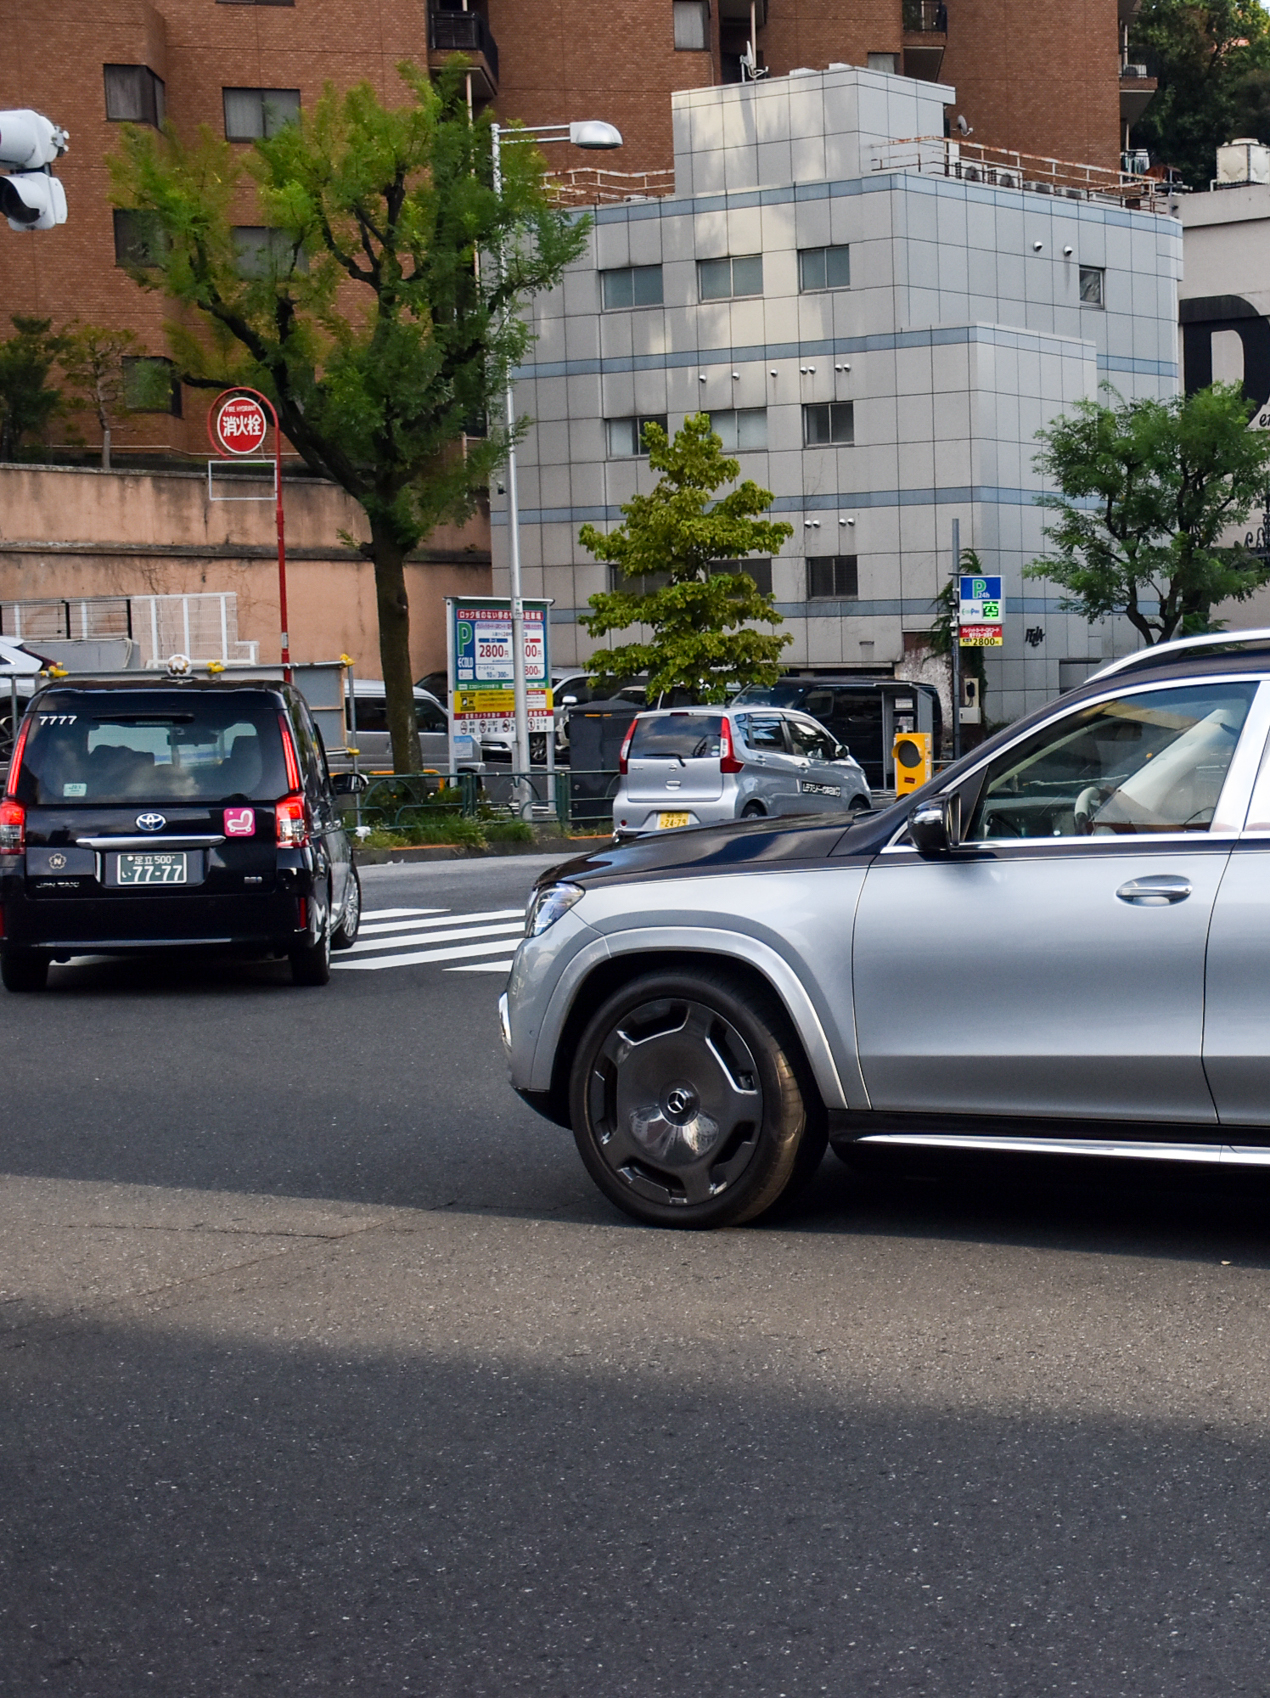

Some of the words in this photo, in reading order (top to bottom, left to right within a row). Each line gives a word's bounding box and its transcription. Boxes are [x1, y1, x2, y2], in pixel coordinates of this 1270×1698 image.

[222, 415, 262, 437] 消火栓
[972, 579, 987, 599] P
[457, 621, 473, 657] P
[39, 715, 78, 726] 7777
[132, 865, 183, 882] 77-77
